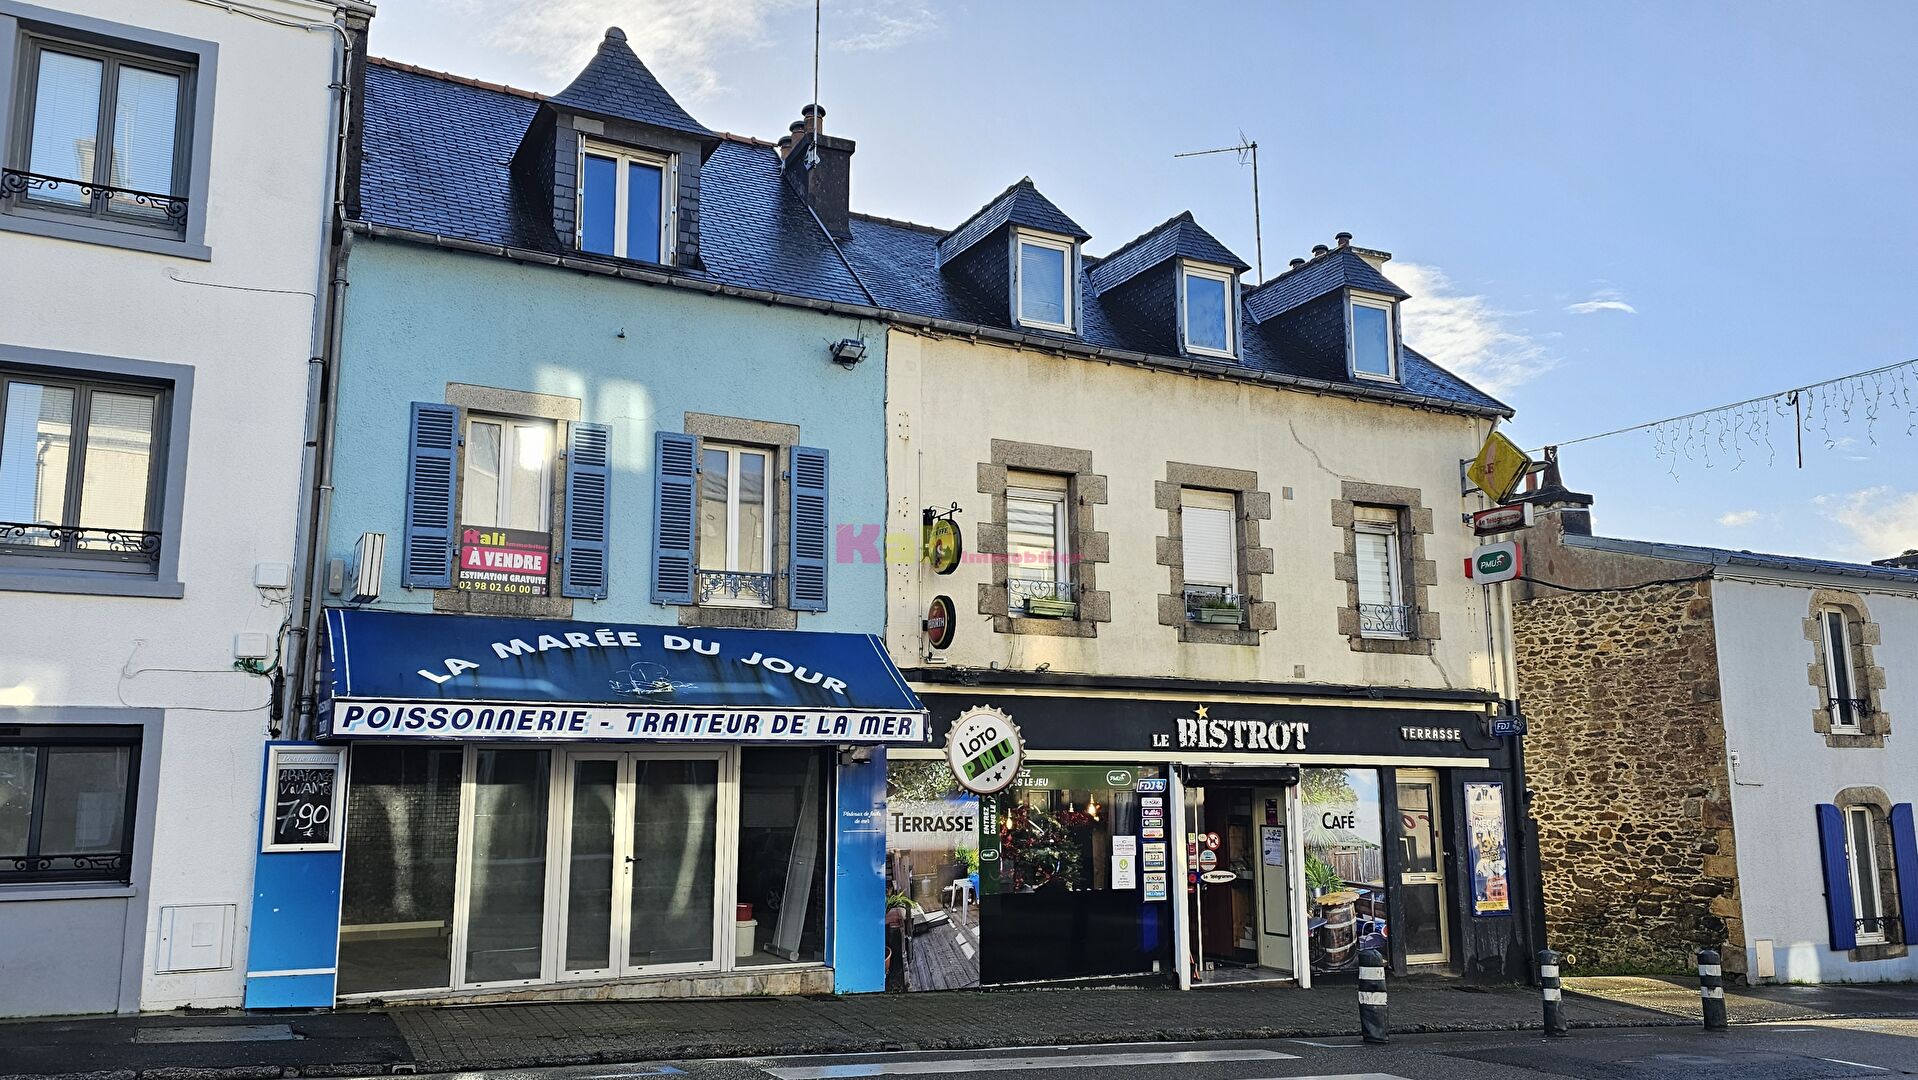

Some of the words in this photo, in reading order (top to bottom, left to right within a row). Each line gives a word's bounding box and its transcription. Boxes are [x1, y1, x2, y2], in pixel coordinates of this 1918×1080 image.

[463, 528, 506, 546] Kali
[468, 547, 481, 566] À
[484, 551, 543, 571] VENDRE
[1480, 559, 1496, 570] PMU
[459, 581, 471, 590] 02
[474, 582, 487, 591] 98
[489, 583, 502, 592] 02
[504, 584, 517, 593] 60
[519, 585, 531, 594] 00
[460, 571, 508, 582] ESTIMATION
[509, 574, 547, 585] GRATUITE
[417, 658, 480, 684] LA
[492, 629, 642, 660] MARÉE
[663, 634, 721, 656] DU
[740, 651, 848, 695] JOUR
[342, 705, 590, 733] POISSONNERIE
[626, 711, 762, 735] TRAITEUR
[770, 714, 807, 735] DE
[816, 715, 848, 735] LA
[858, 716, 914, 737] MER
[1496, 722, 1510, 730] FDJ
[959, 727, 997, 758] LOTO
[1152, 733, 1170, 747] LE
[1176, 718, 1309, 750] BISTROT
[1401, 727, 1461, 741] TERRASSE
[962, 738, 1015, 781] PMU
[1024, 778, 1033, 787] LE
[1034, 778, 1049, 787] JEU
[1138, 781, 1156, 790] FDJ
[277, 799, 330, 834] 7,90
[891, 812, 974, 833] TERRASSE
[1321, 810, 1355, 829] CAFÉ
